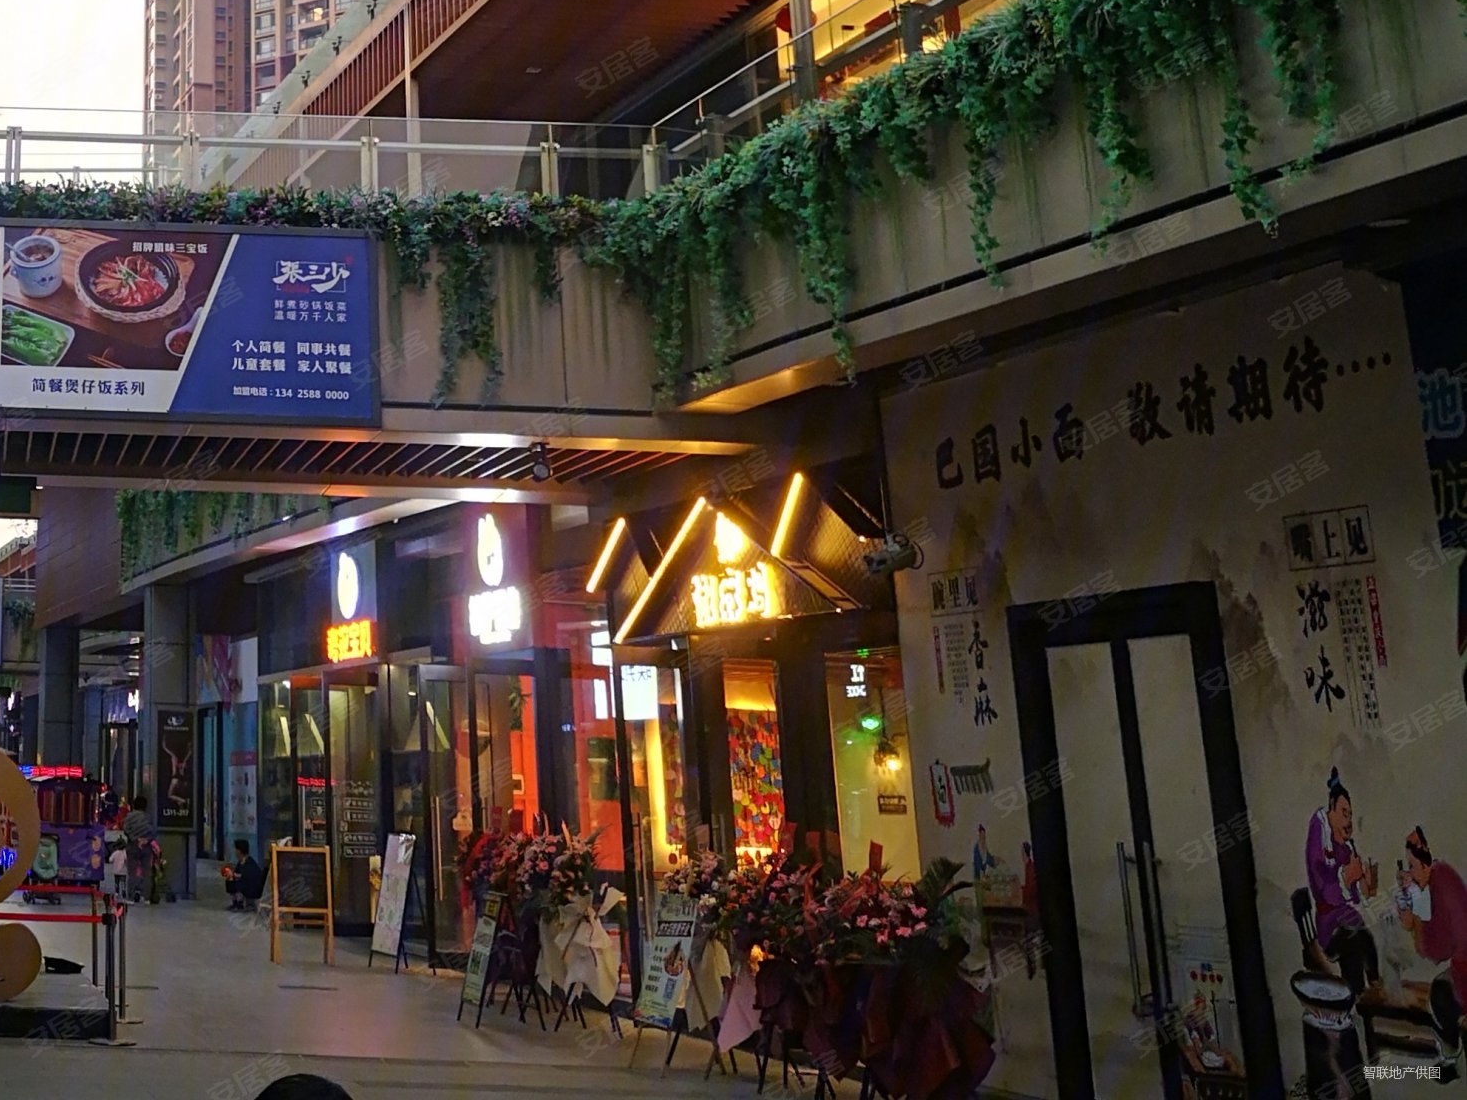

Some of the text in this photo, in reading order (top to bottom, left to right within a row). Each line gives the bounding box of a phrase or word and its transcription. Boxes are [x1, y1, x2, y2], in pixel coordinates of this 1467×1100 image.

[132, 241, 208, 254] 招牌腊味三宝饭
[274, 299, 347, 312] 鲜煮砂锅饭菜
[274, 311, 347, 323] 温暖万千人家
[232, 340, 351, 357] 个人简餐 同事共餐
[232, 358, 352, 375] 儿童套餐 家人聚餐
[32, 378, 145, 396] 简餐煲仔饭系列
[297, 388, 321, 399] 2588
[325, 390, 350, 400] 0000
[936, 403, 1085, 490] 巴国小面
